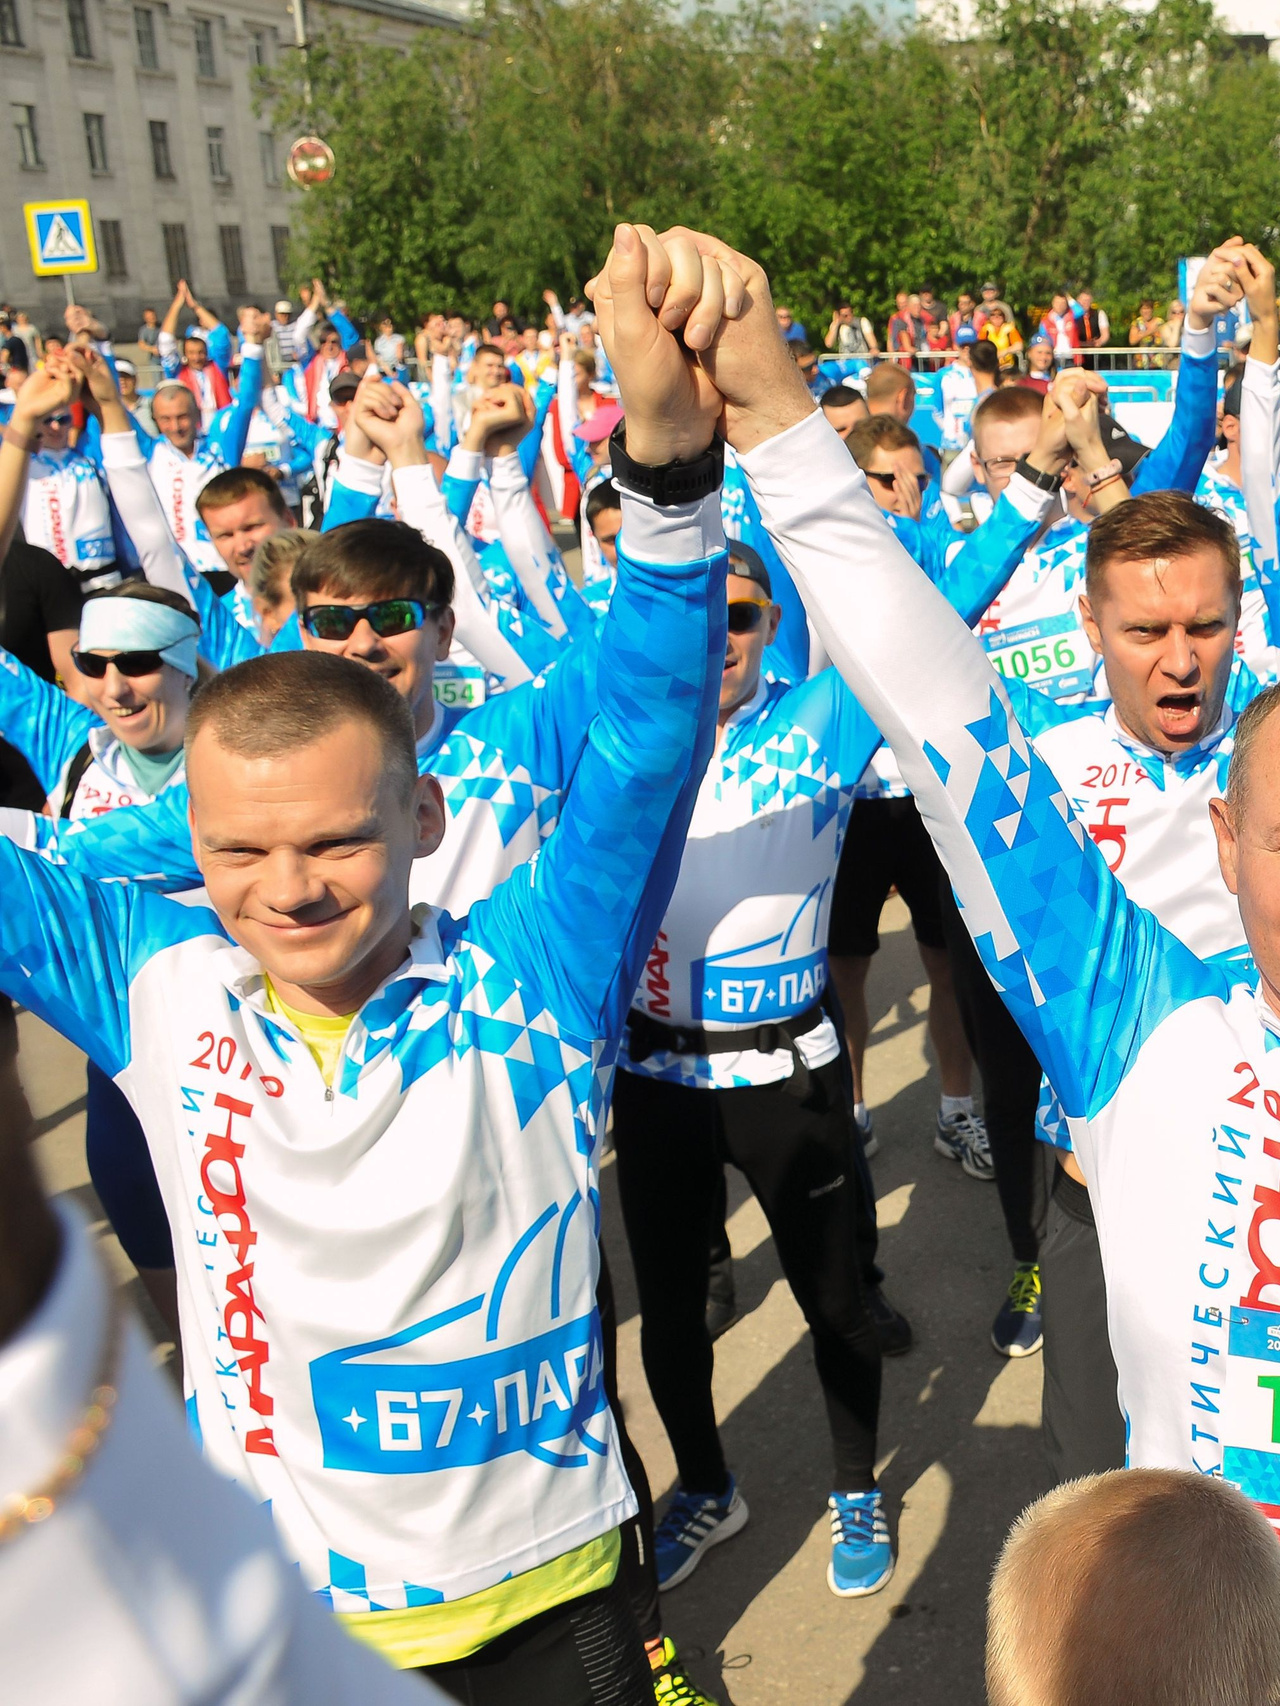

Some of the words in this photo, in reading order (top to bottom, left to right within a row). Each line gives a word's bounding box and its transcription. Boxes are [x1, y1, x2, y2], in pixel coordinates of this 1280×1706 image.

[992, 638, 1075, 680] 1056
[720, 978, 766, 1013] 67
[376, 1387, 463, 1451] 67
